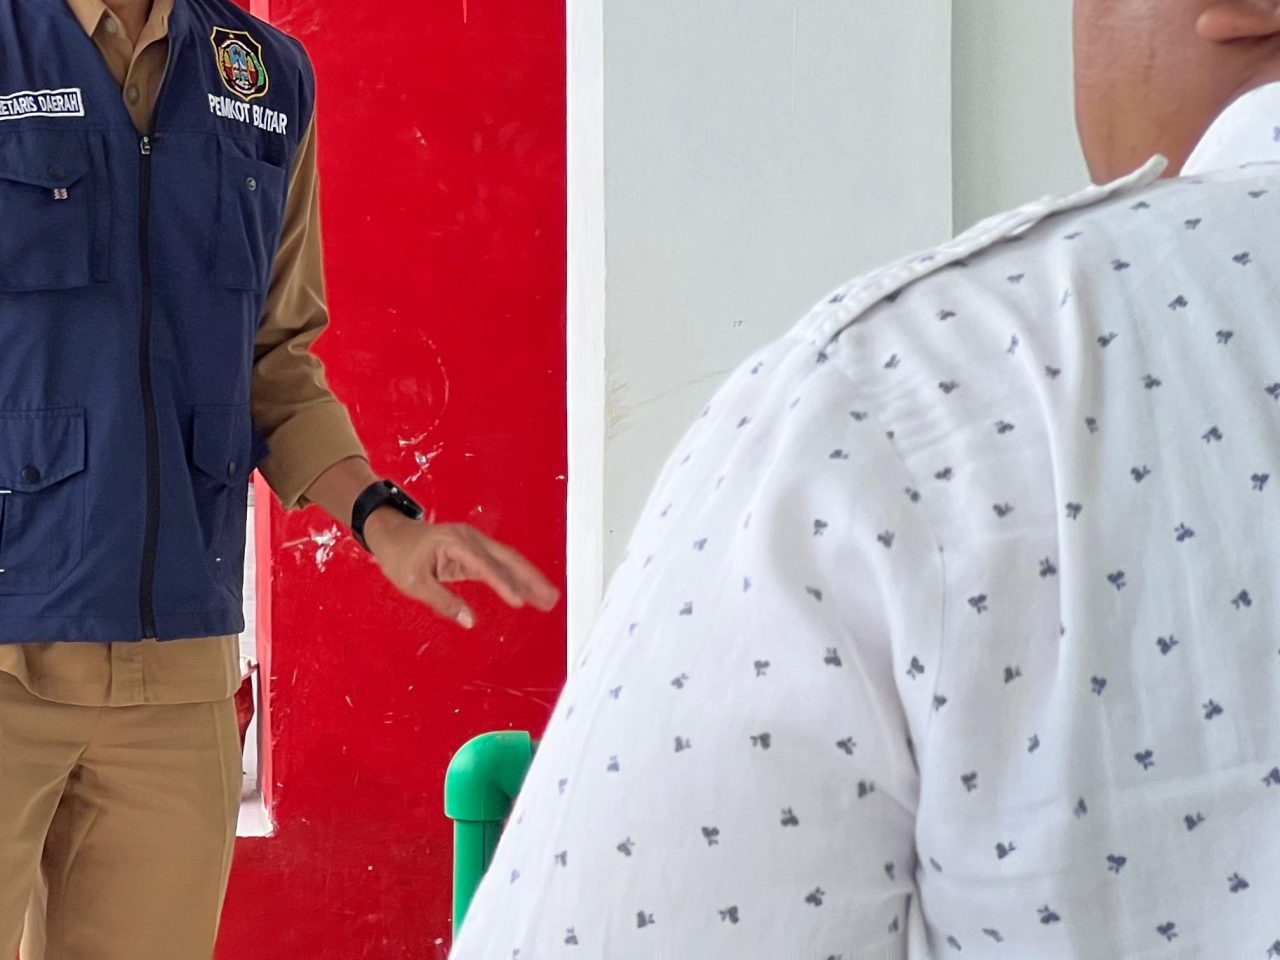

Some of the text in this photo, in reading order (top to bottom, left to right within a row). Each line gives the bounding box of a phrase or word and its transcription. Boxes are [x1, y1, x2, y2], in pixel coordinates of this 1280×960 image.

[38, 93, 79, 112] DAERAH
[207, 93, 288, 136] PEMKOT BLITAR
